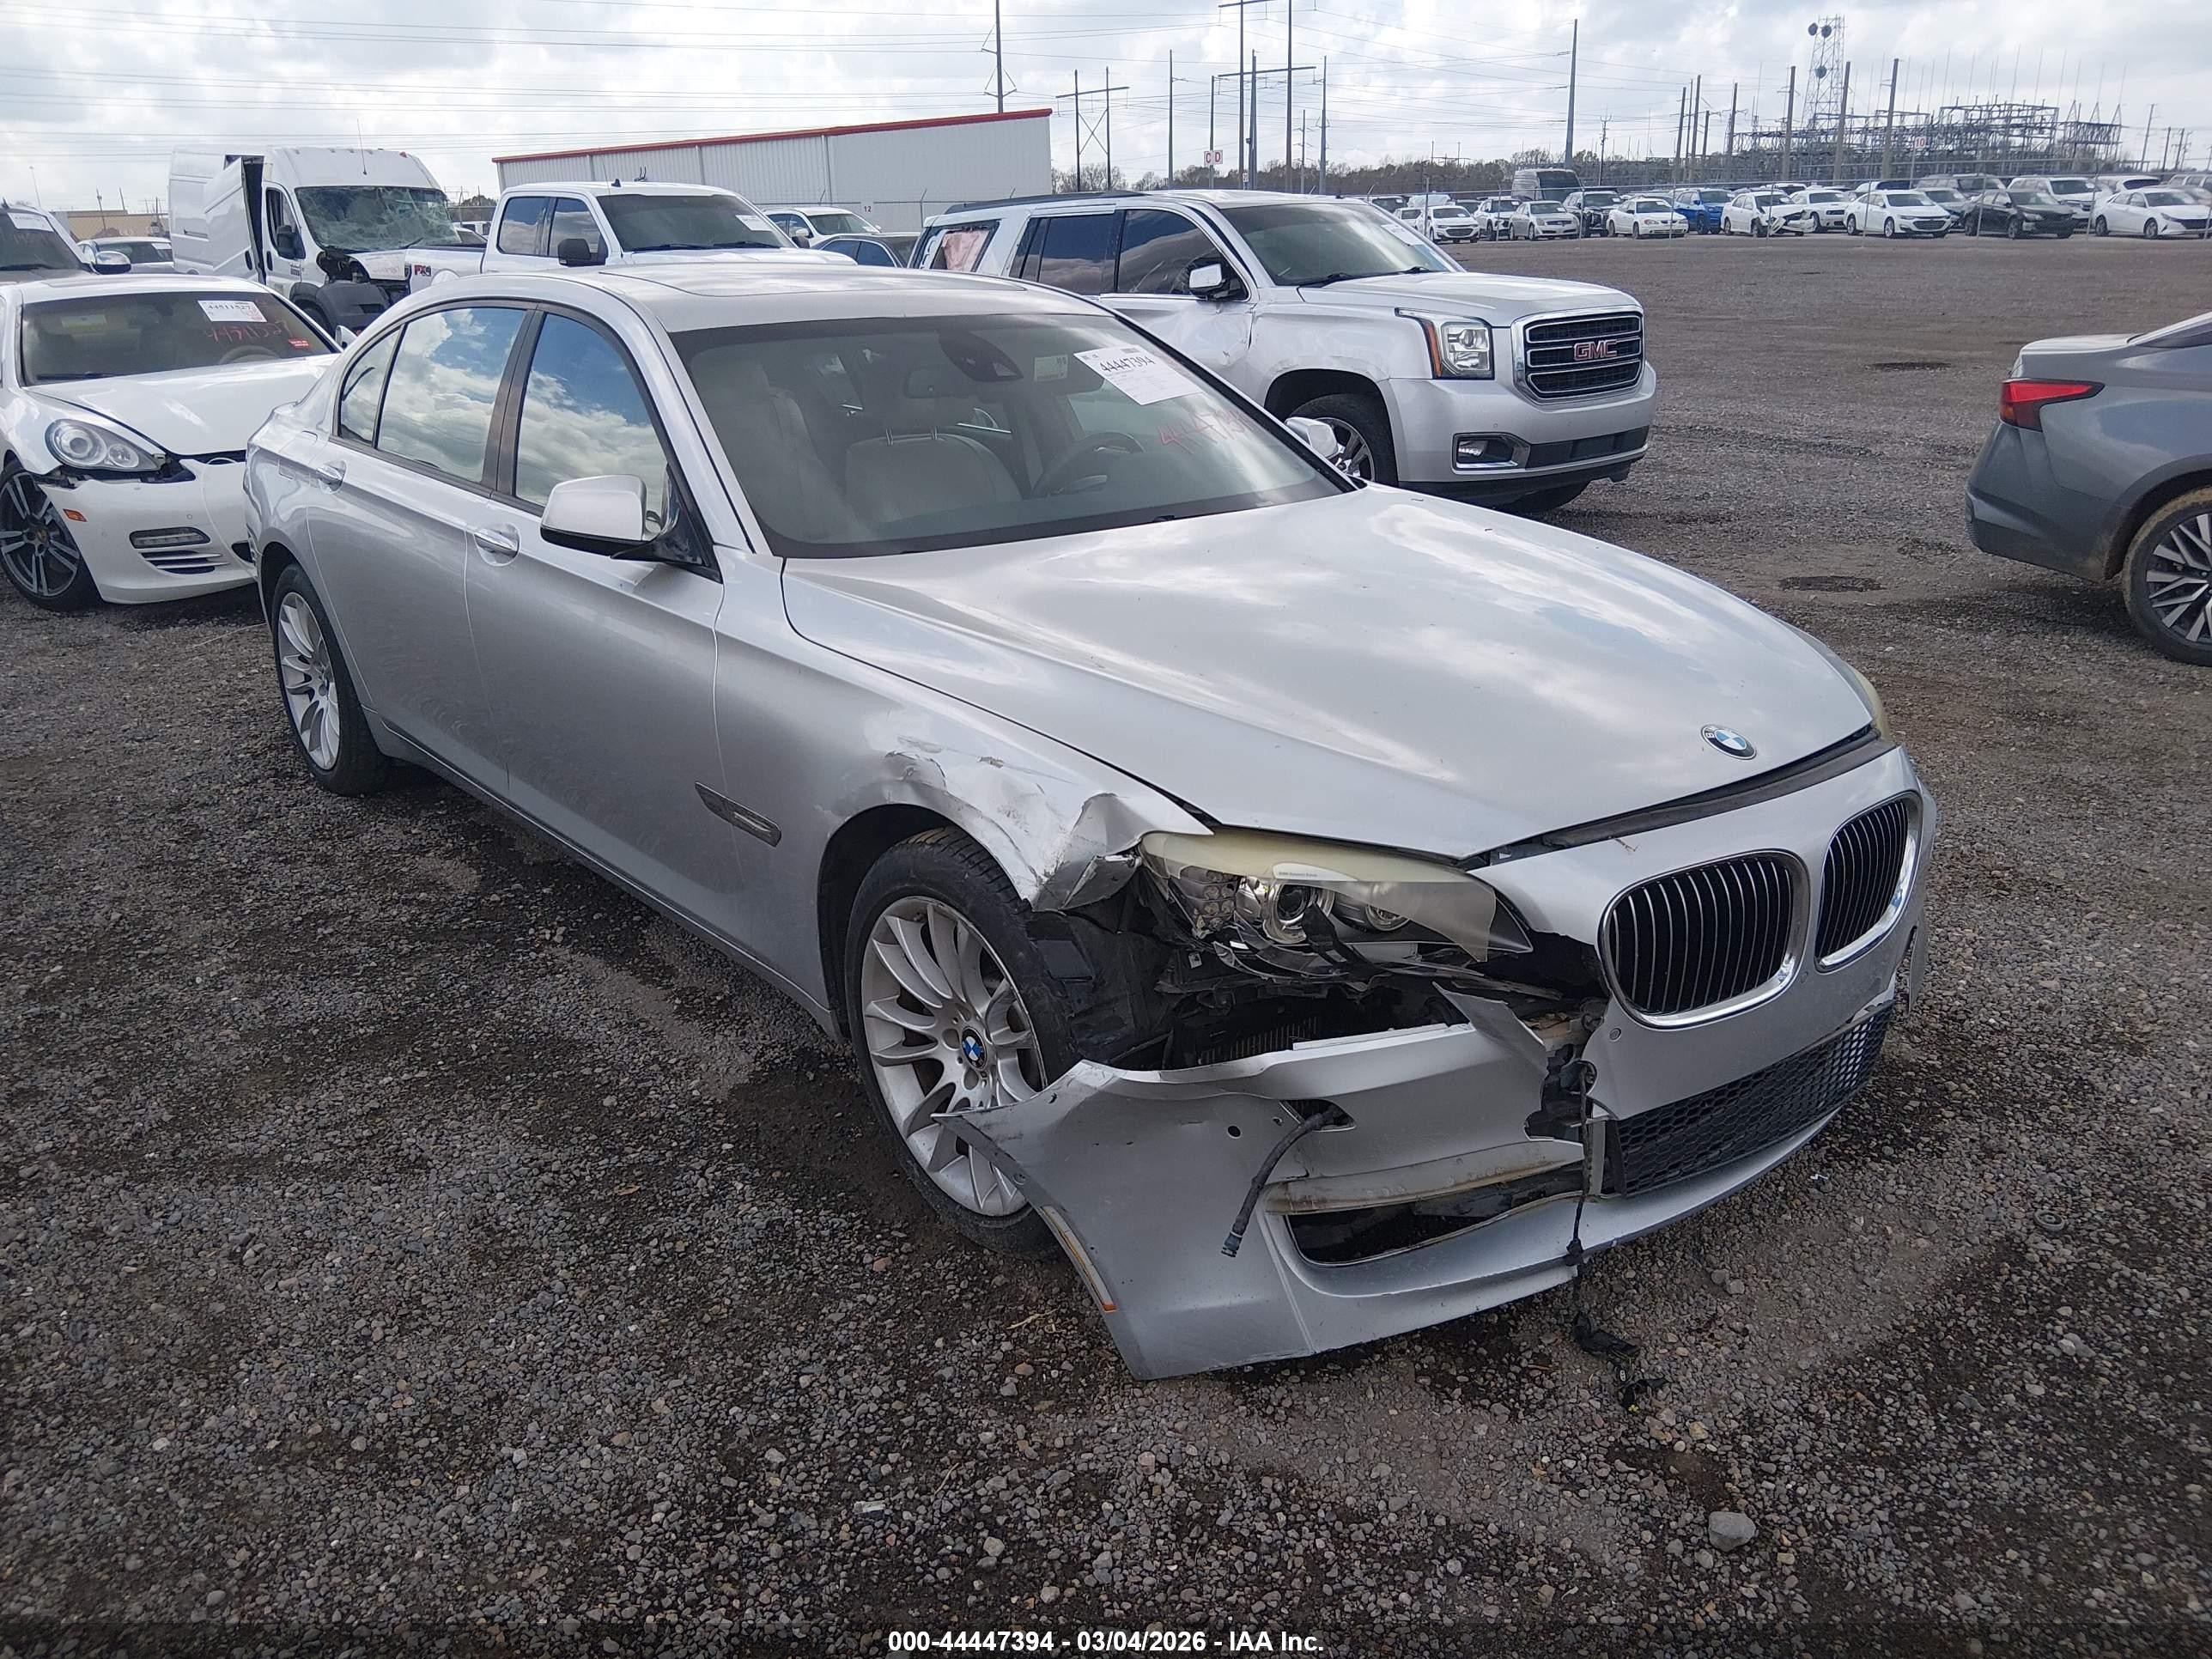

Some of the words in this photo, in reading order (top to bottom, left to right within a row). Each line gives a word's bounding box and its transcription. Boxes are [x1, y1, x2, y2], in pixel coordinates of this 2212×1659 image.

[1916, 137, 1925, 148] 10
[1206, 152, 1212, 163] C
[1214, 151, 1221, 162] D
[1574, 339, 1618, 361] GMC
[1099, 356, 1156, 373] 44447394
